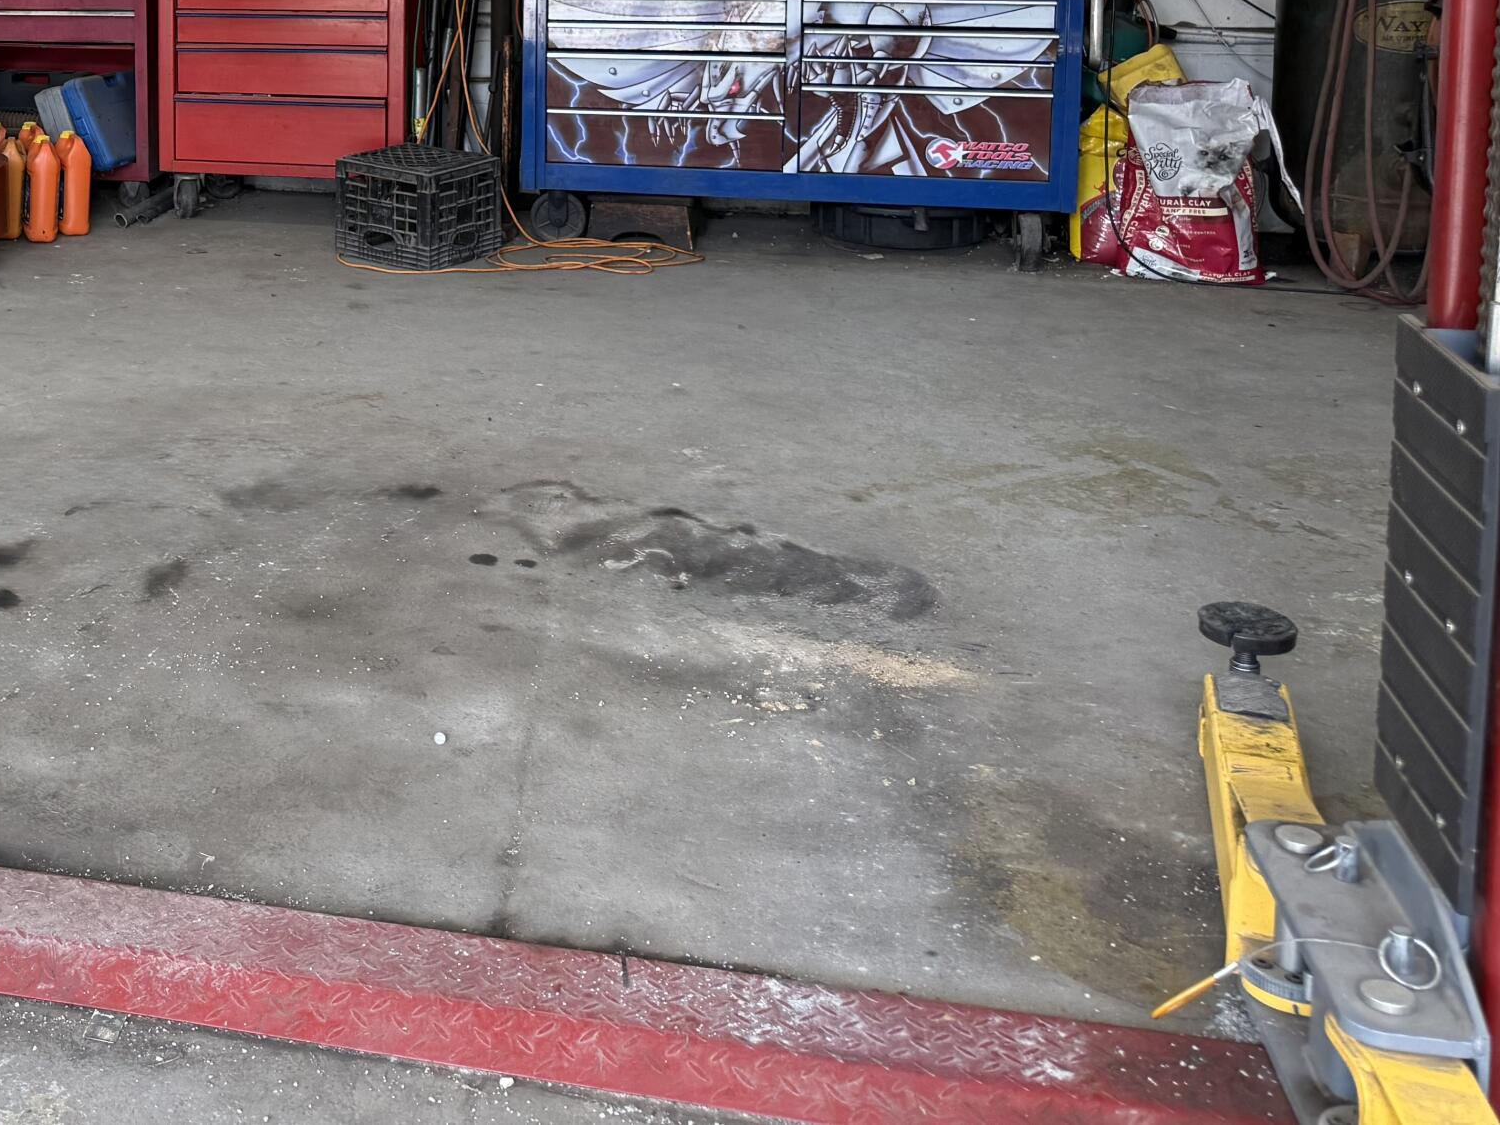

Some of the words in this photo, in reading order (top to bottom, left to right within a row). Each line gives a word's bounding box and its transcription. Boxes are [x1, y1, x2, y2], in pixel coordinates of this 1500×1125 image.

[958, 141, 1029, 151] MATCO
[966, 151, 1032, 161] TOOLS
[1143, 142, 1181, 161] Special
[956, 159, 1034, 170] RACING
[1160, 199, 1186, 207] URAL
[1123, 220, 1139, 245] CLAY
